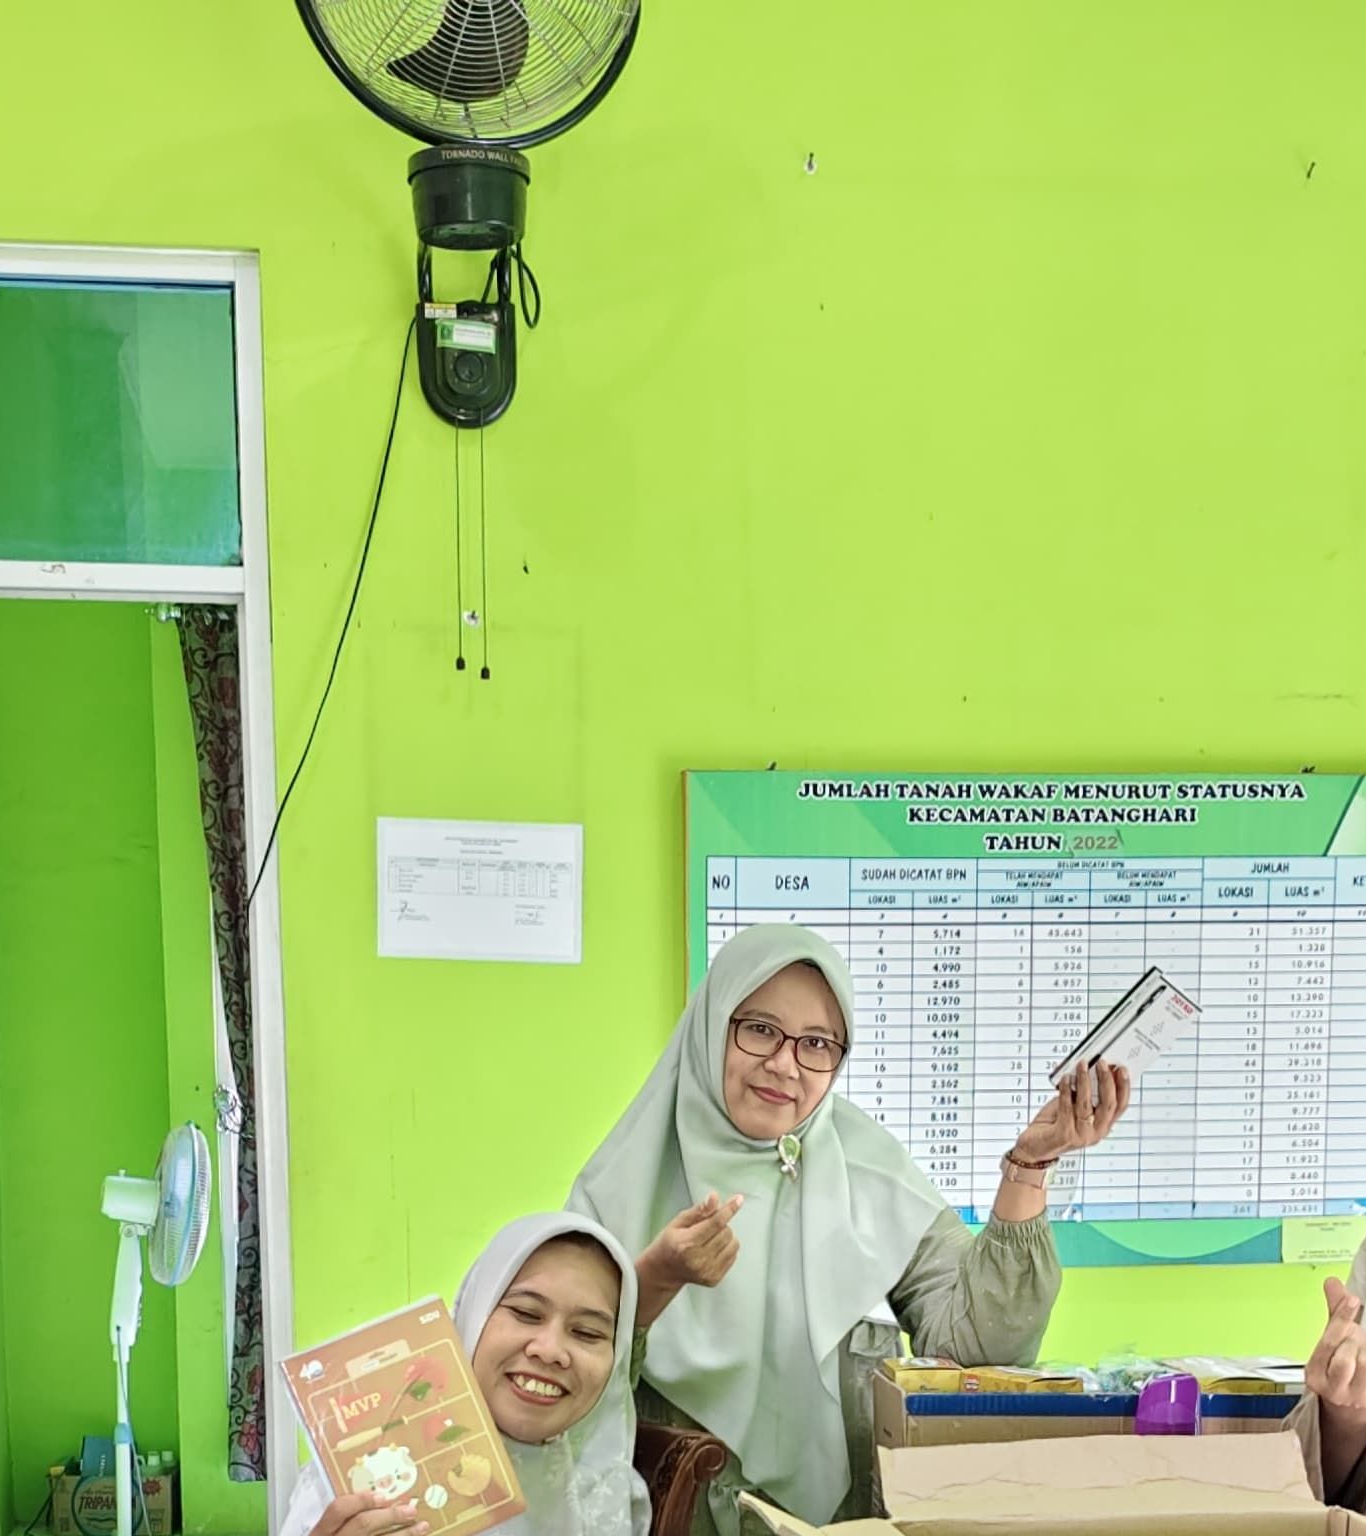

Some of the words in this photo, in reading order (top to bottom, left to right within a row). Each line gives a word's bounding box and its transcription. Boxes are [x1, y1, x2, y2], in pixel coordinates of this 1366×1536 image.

[487, 151, 508, 161] WALL
[798, 782, 889, 798] JUMLAH
[895, 783, 972, 799] TANAH
[978, 784, 1058, 799] WAKAF
[1064, 784, 1171, 799] MENURUT
[1177, 783, 1304, 798] STATUSNYA
[908, 807, 1045, 822] KECAMATAN
[1052, 808, 1196, 822] BATANGHARI
[986, 836, 1061, 850] TAHUN
[1073, 836, 1118, 850] 2022
[1251, 862, 1289, 873] JUMLAH
[861, 869, 896, 881] SUDAH
[899, 868, 943, 880] DICATAT
[946, 868, 967, 880] BPN
[712, 875, 730, 889] NO
[775, 875, 809, 890] DESA
[1218, 886, 1253, 897] LOKASI
[1285, 886, 1309, 896] LUAS
[868, 895, 896, 904] LOKASI
[928, 895, 948, 904] LUAS
[991, 895, 1018, 904] LOKASI
[1045, 895, 1064, 903] LUAS
[1104, 895, 1131, 903] LOKASI
[1158, 894, 1177, 903] LUAS
[341, 1393, 382, 1420] MVP
